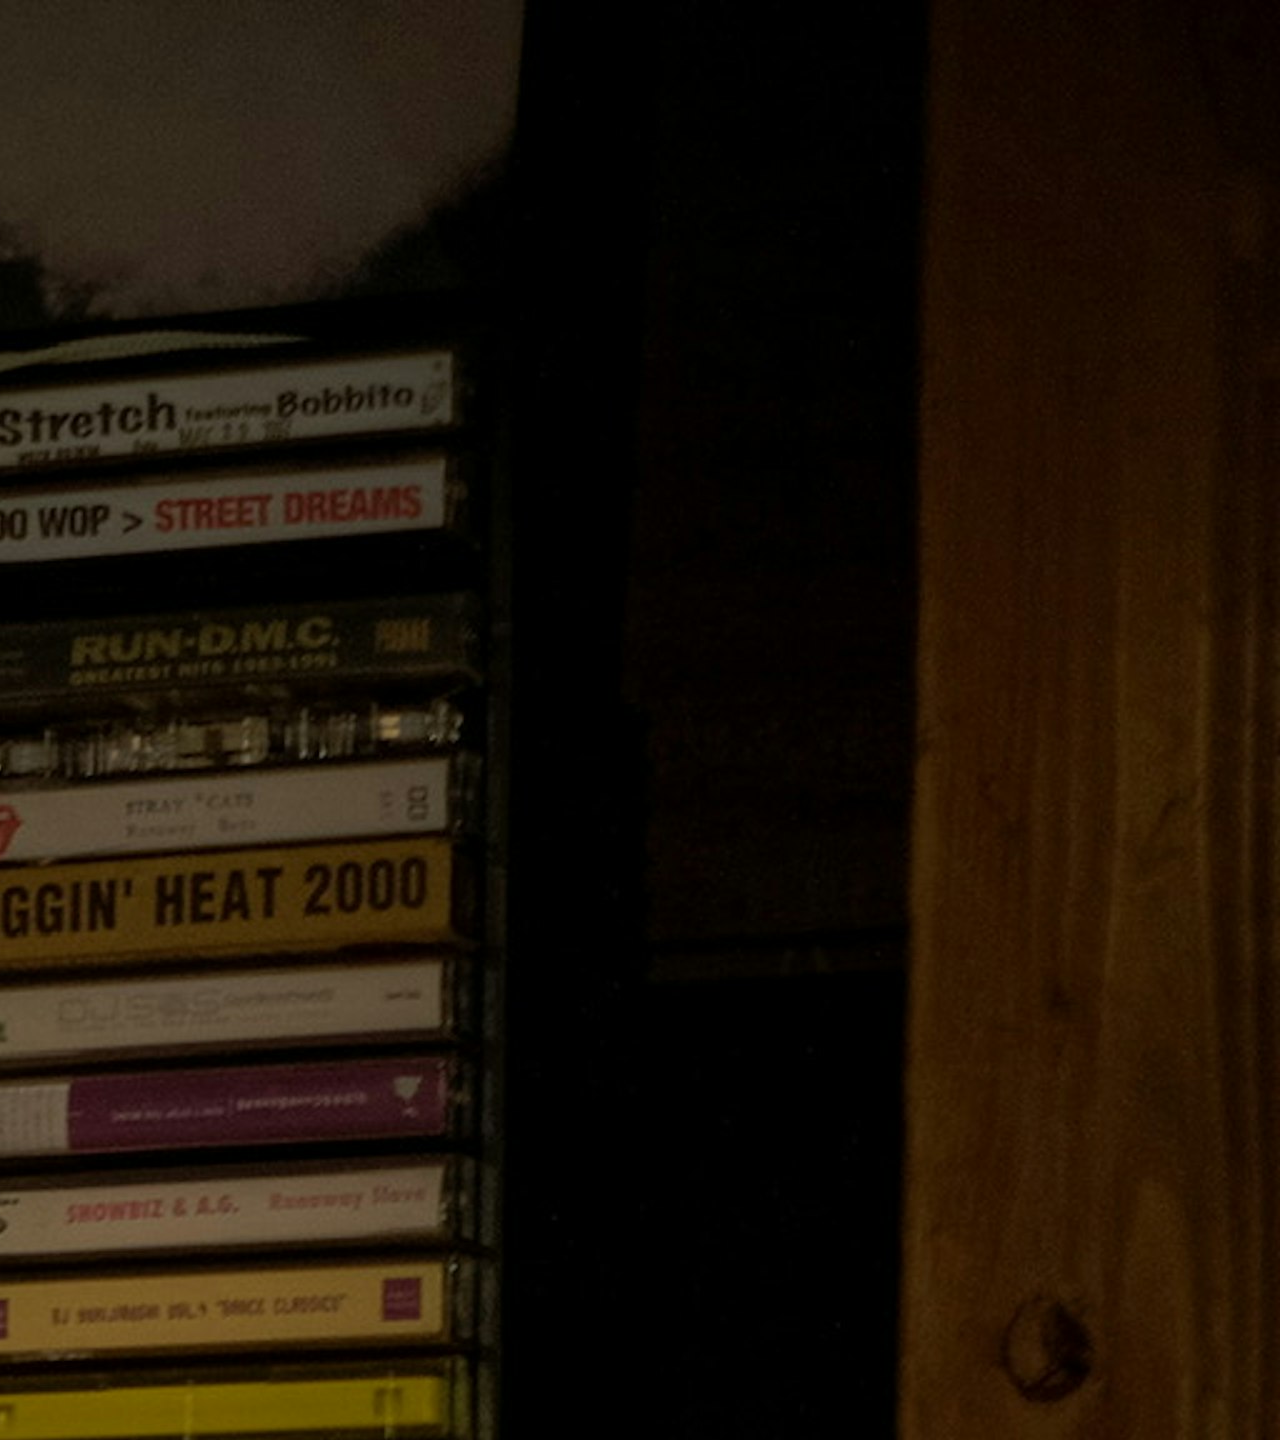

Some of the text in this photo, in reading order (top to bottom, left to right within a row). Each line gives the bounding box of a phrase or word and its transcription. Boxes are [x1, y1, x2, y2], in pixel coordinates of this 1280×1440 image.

[39, 505, 110, 538] WOP
[154, 496, 275, 532] STREET
[283, 486, 423, 524] DREAMS
[155, 867, 283, 927] HEAT
[303, 858, 428, 916] 2000
